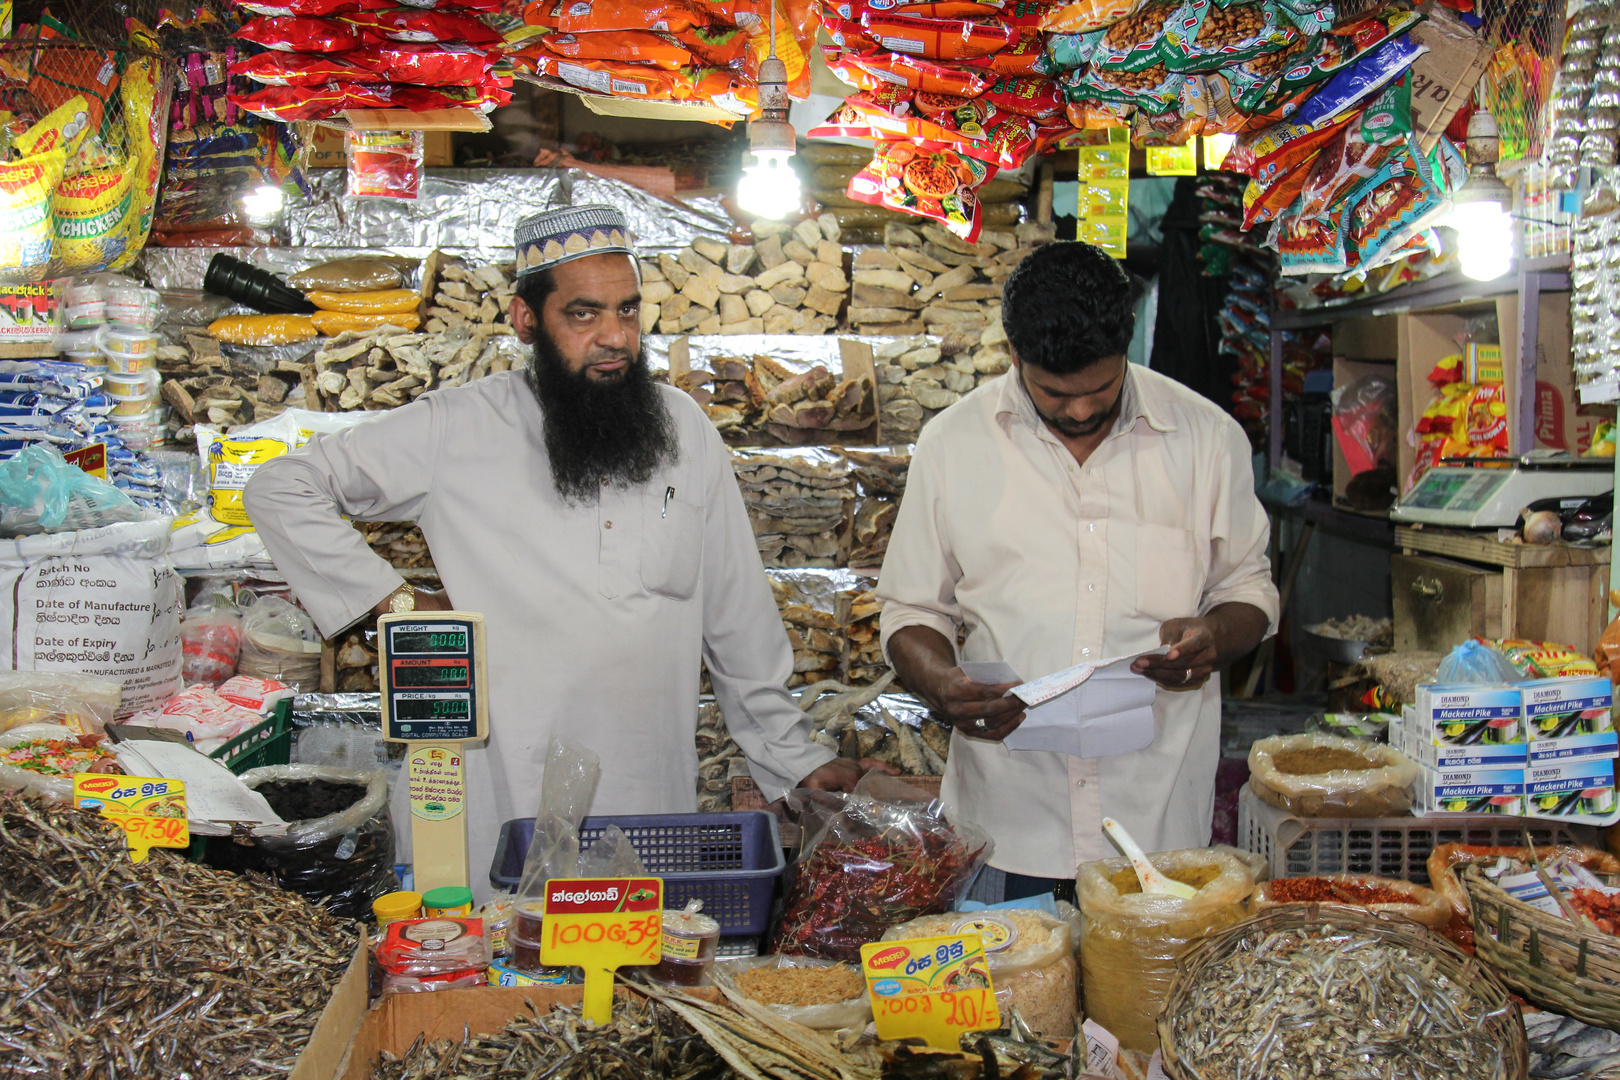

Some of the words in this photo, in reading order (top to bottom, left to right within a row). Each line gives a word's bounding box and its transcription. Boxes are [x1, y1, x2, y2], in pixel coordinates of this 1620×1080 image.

[315, 150, 333, 160] OF
[62, 174, 114, 192] Maggi
[60, 207, 123, 237] CHICKEN
[1540, 390, 1555, 440] Prima
[39, 565, 70, 577] Batch
[74, 565, 90, 573] No
[79, 578, 117, 588] අංකය
[36, 600, 65, 609] Date
[68, 600, 81, 609] of
[84, 600, 151, 612] Manufacture
[94, 614, 121, 626] දිනය
[35, 637, 64, 646] Date
[68, 638, 79, 647] of
[82, 638, 117, 650] Expiry
[113, 652, 135, 664] දිනය
[82, 668, 139, 676] NUFACTURED
[1533, 690, 1561, 698] DIAMOND
[1441, 709, 1474, 718] Mackerel
[1475, 709, 1491, 717] Pike
[1534, 702, 1566, 714] Mackerel
[1567, 701, 1583, 709] Pike
[1532, 768, 1560, 777] DIAMOND
[83, 781, 114, 789] Maggi
[111, 788, 136, 799] රස
[141, 782, 168, 797] මුසු
[1442, 787, 1475, 796] Mackerel
[1477, 786, 1493, 794] Pike
[1533, 781, 1566, 792] Mackerel
[1567, 780, 1583, 788] Pike
[552, 887, 619, 904] ක්ලෝගාඩ්
[872, 950, 906, 967] Maggi
[905, 954, 932, 975] රස
[936, 940, 964, 966] මුසු
